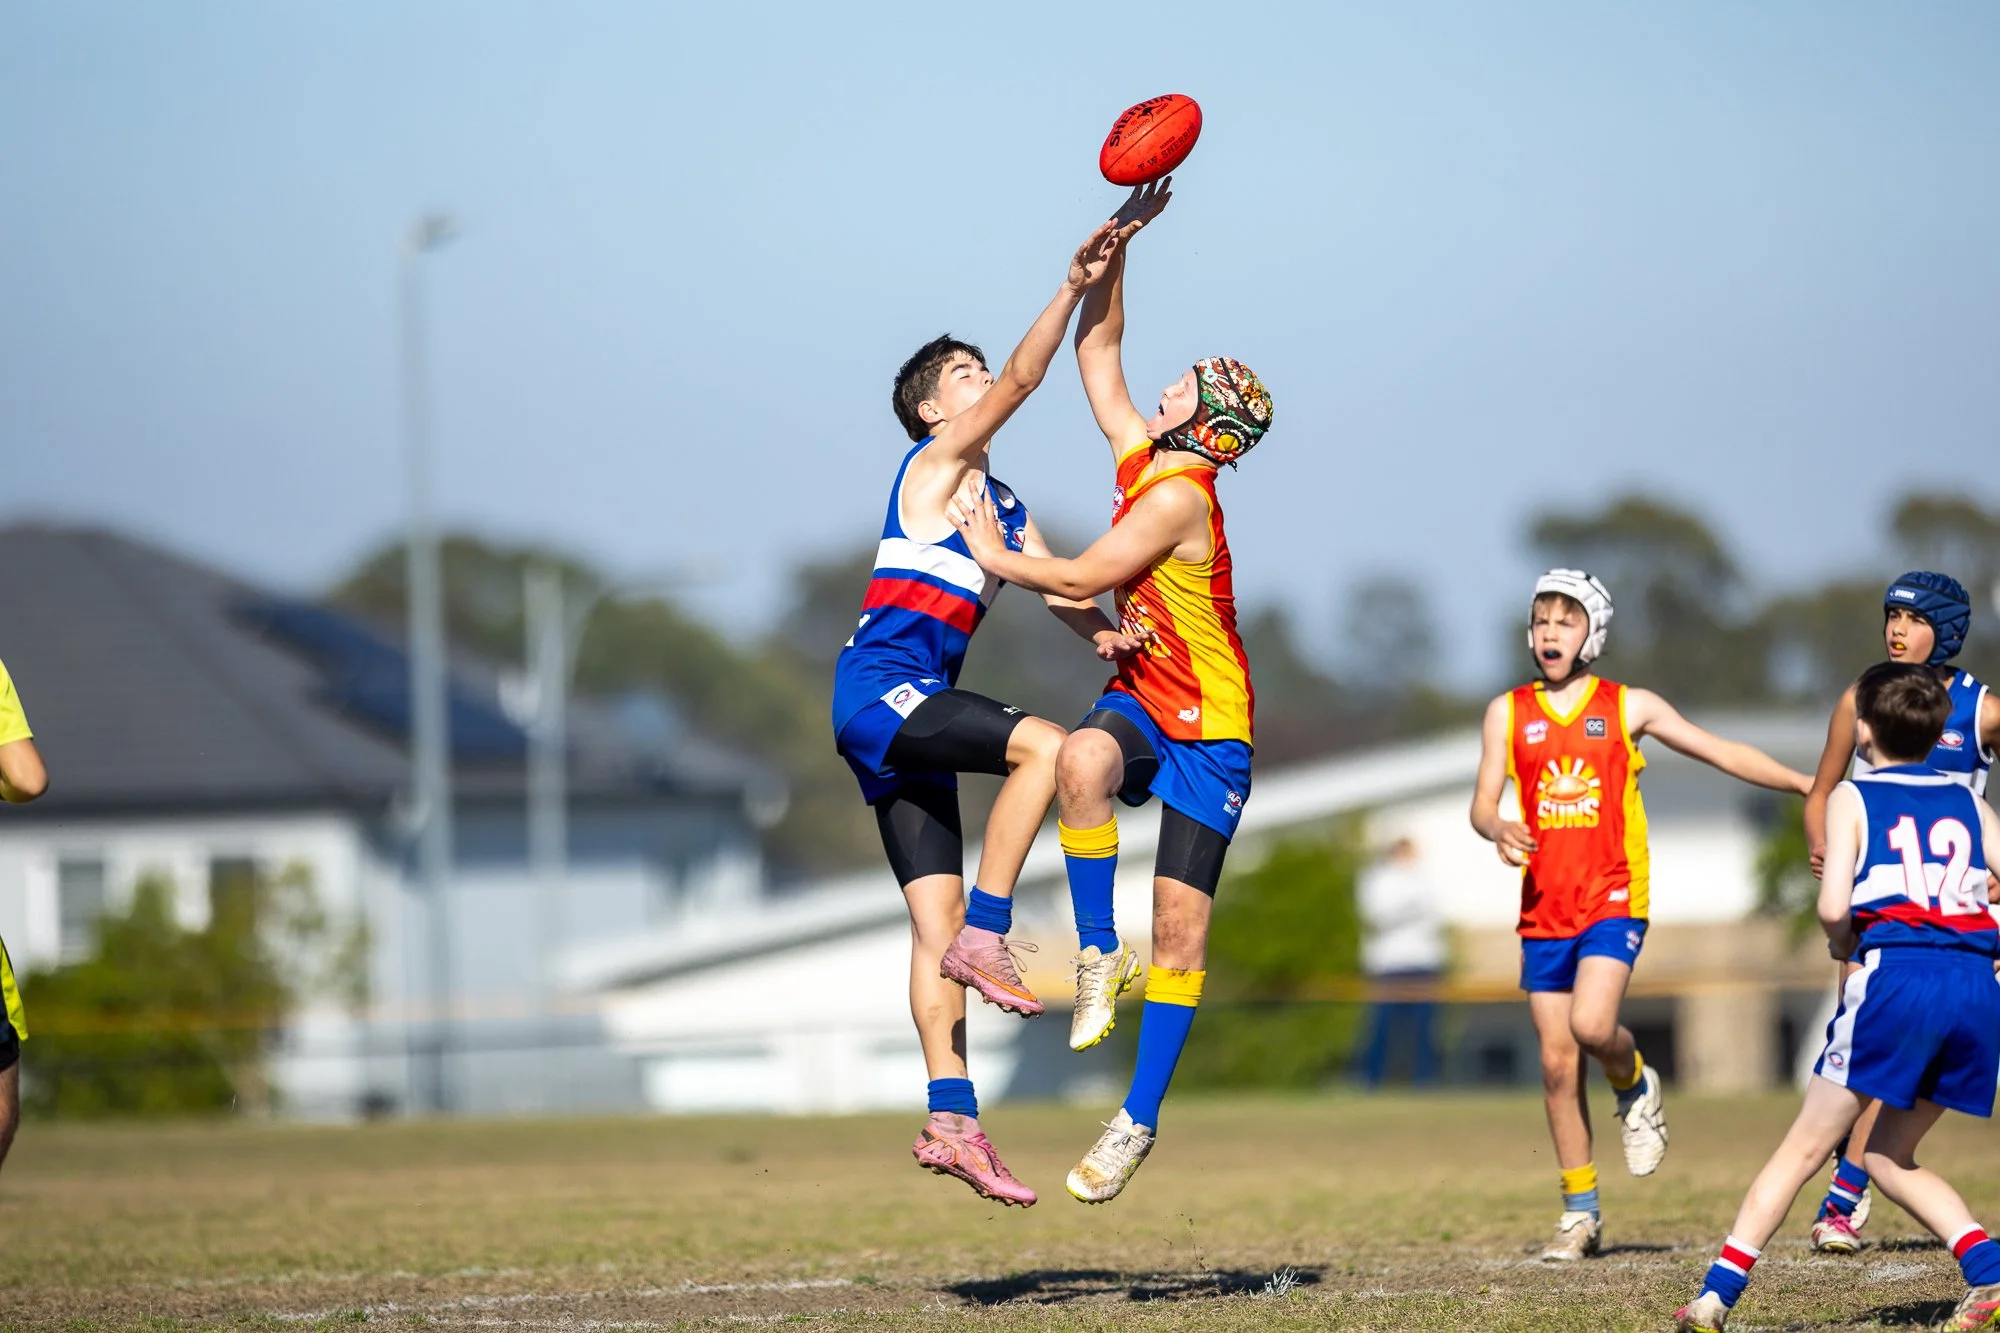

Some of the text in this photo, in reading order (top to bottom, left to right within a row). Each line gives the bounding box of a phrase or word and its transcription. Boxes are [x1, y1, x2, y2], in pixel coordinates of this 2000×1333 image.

[1161, 123, 1196, 159] SHERRIN
[1537, 798, 1601, 831] SUNS
[1887, 814, 1982, 916] 12
